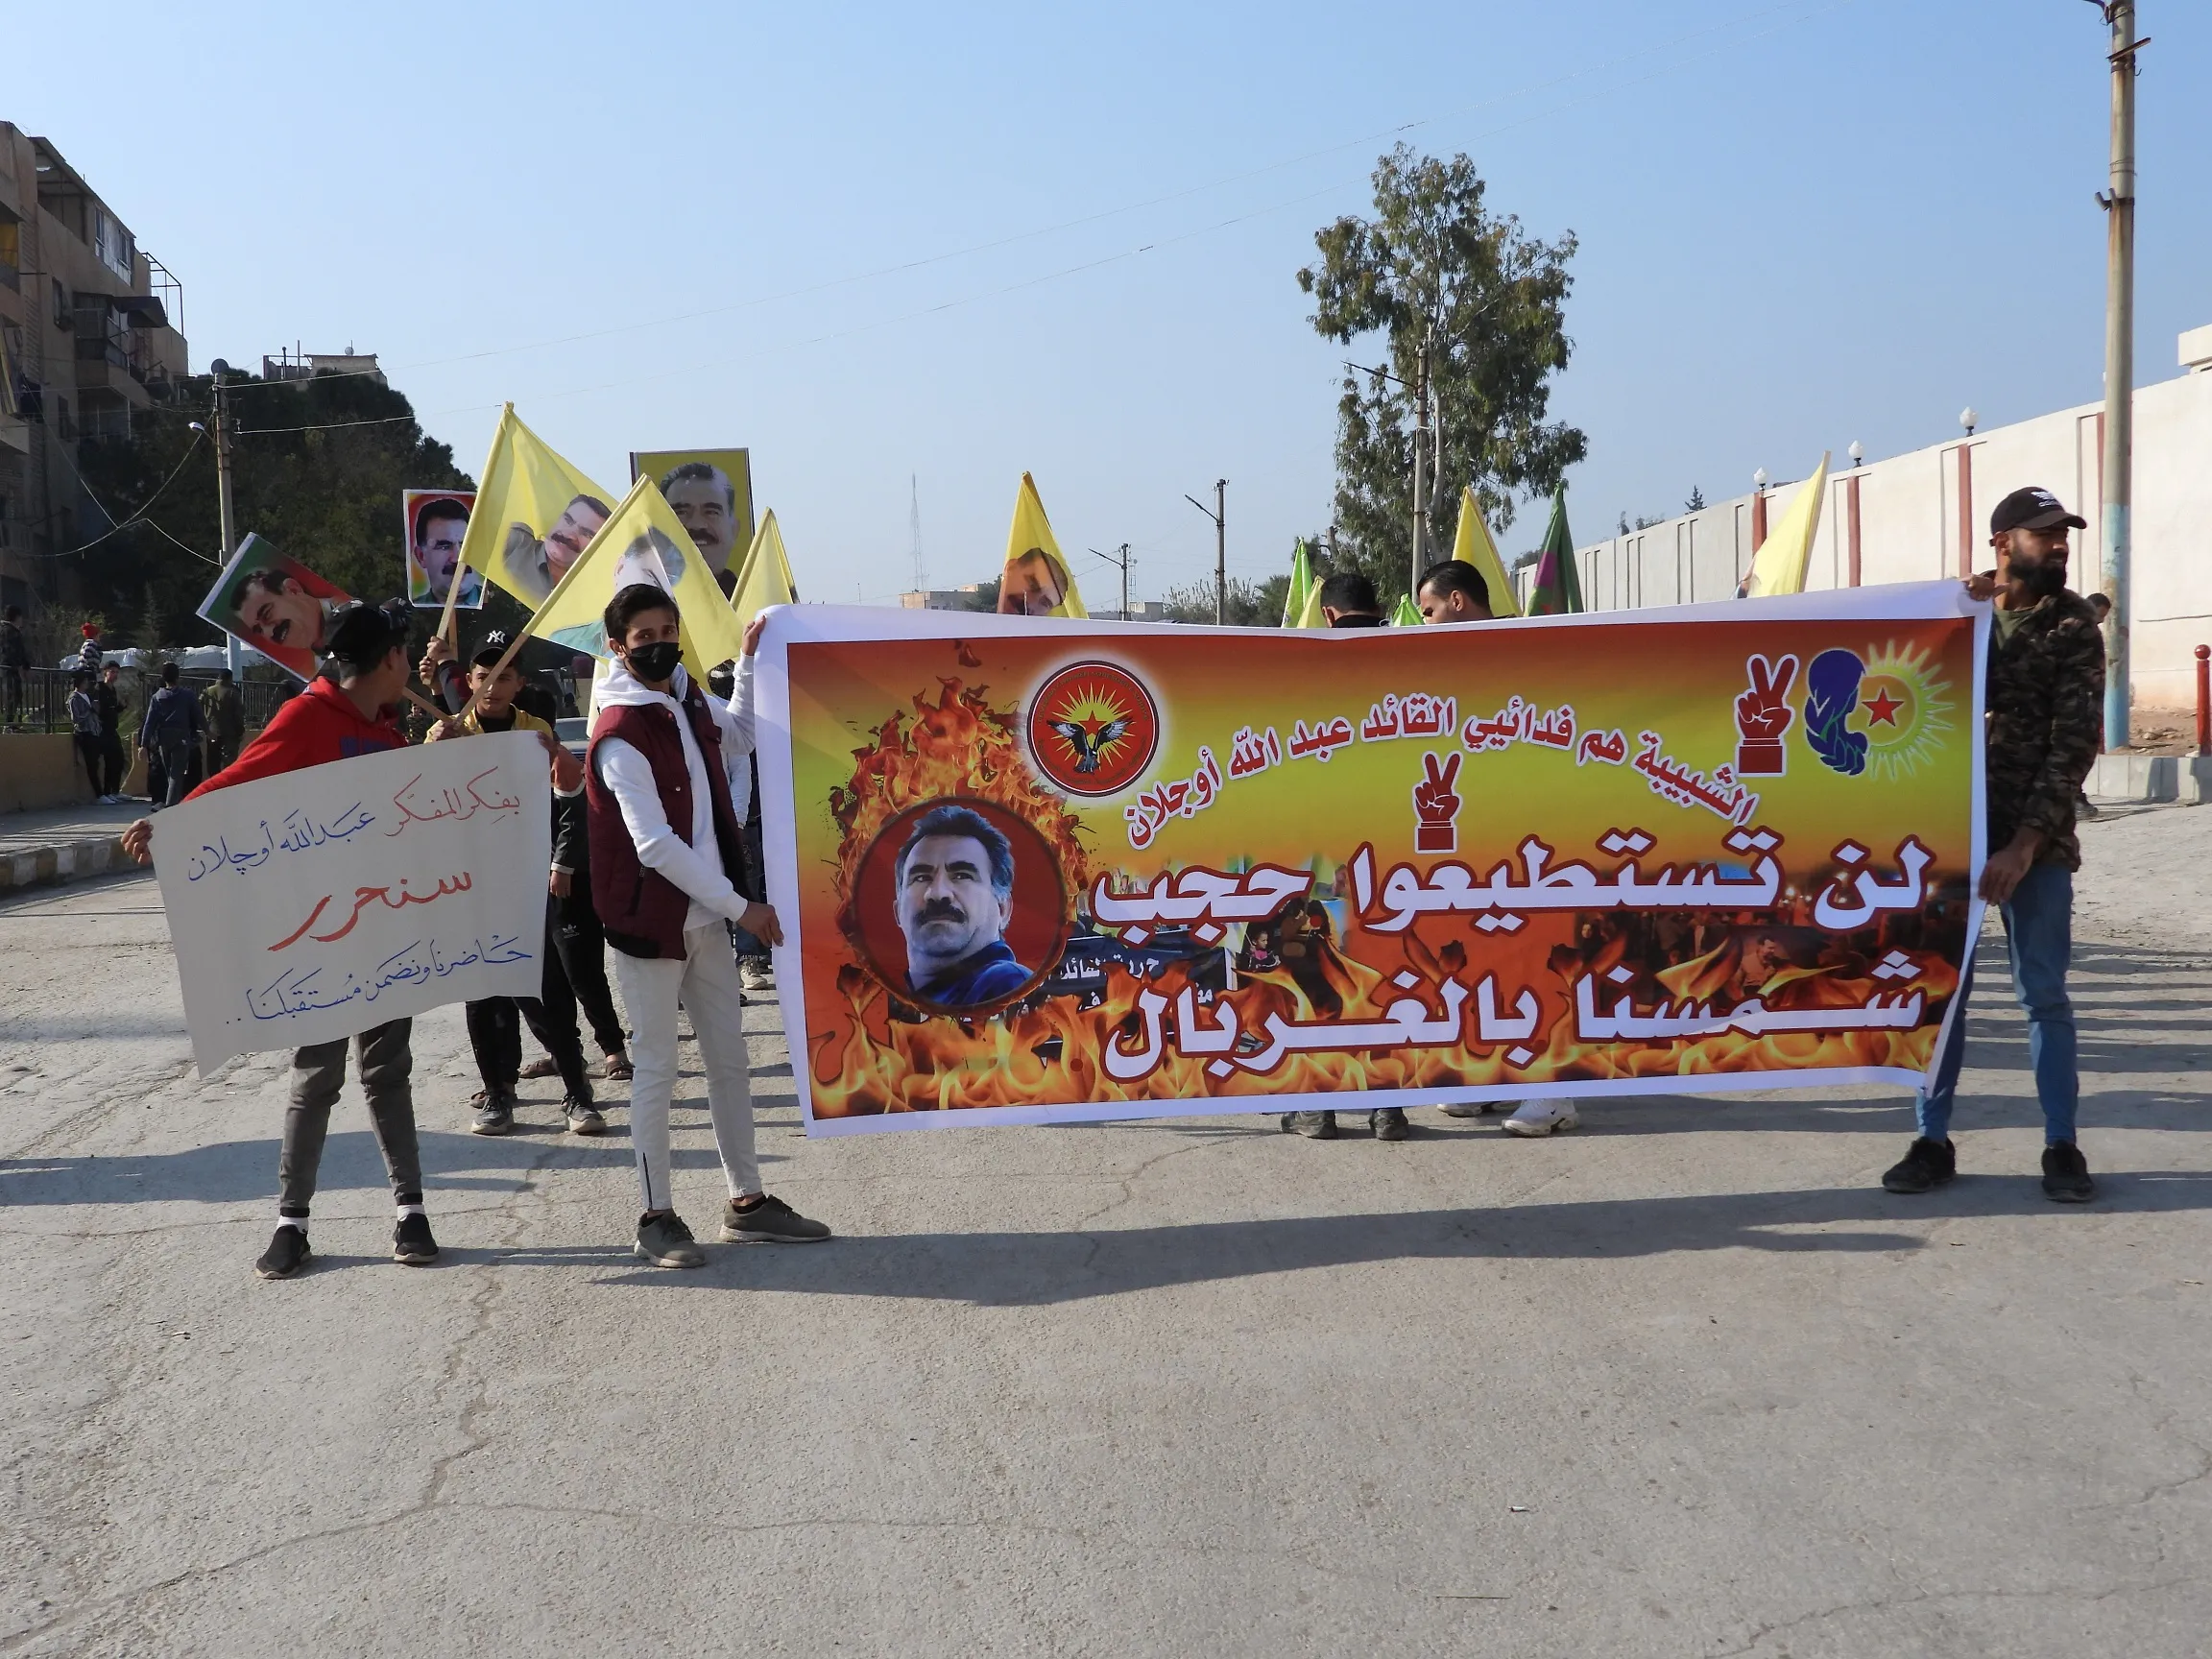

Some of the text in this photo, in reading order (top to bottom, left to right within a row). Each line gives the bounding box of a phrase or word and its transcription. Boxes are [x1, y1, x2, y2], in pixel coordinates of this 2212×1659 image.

[1288, 718, 1353, 760] عبد
[1361, 694, 1455, 740] القائد
[1462, 697, 1575, 751] فدائيي
[1578, 731, 1626, 765] هم
[1229, 727, 1281, 779] الله
[1633, 732, 1758, 825] الشبيبة
[1125, 746, 1221, 848] أوجلان
[268, 872, 472, 952] سنحرر
[1092, 825, 1935, 948] لن تستطيعوا حجب
[1104, 950, 1927, 1082] شمسنا بالغربال
